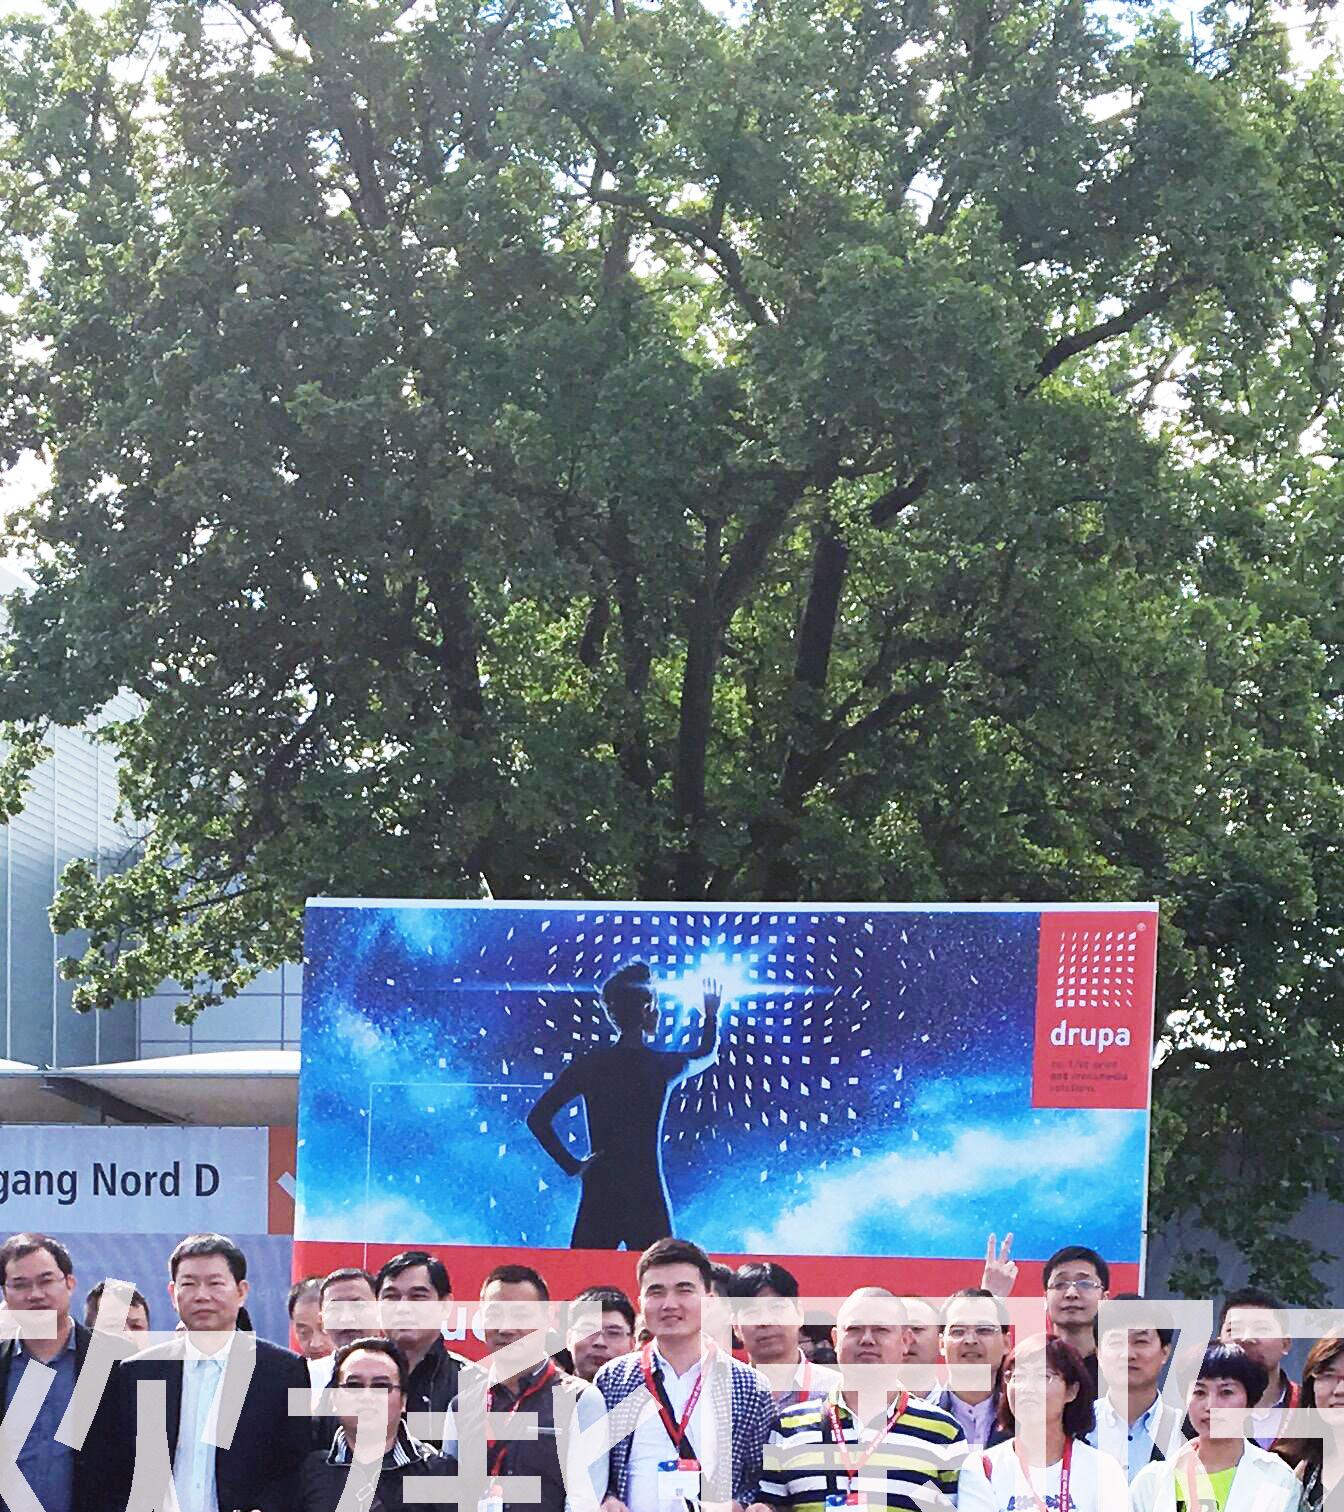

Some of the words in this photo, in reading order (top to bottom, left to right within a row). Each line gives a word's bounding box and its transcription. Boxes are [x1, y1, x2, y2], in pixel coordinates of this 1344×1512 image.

[1050, 1020, 1131, 1054] drupa
[92, 1159, 186, 1198] Nord
[194, 1163, 220, 1198] D
